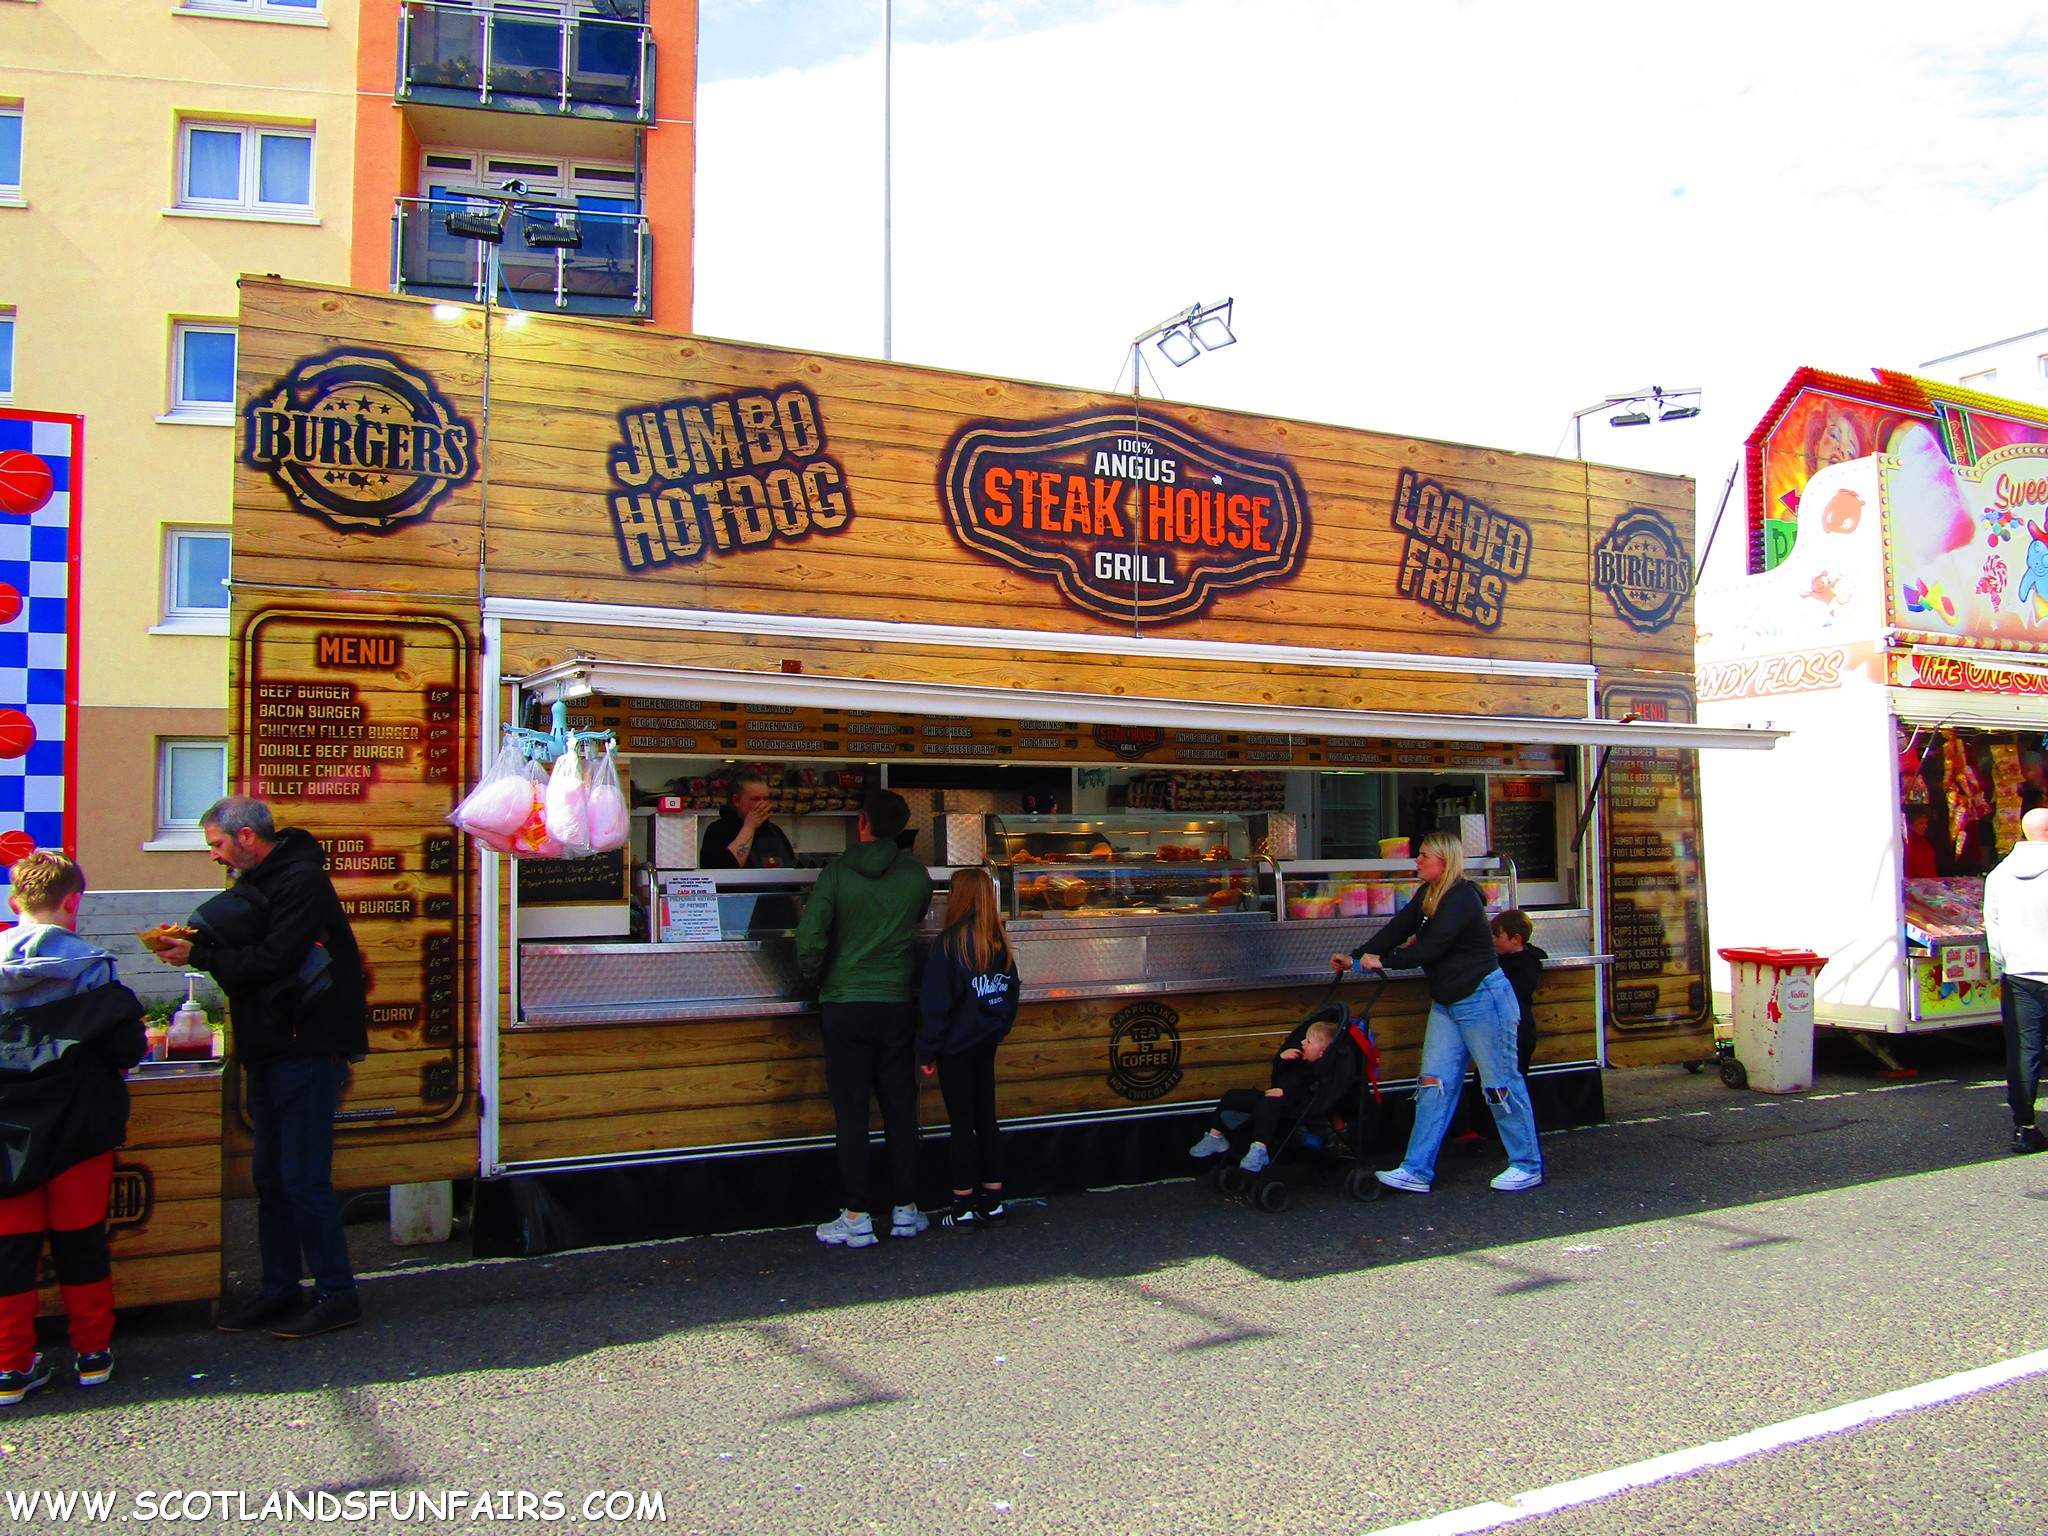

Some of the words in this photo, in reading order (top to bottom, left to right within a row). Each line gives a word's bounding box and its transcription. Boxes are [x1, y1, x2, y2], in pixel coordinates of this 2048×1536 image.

[258, 410, 470, 477] BURGERS
[616, 390, 818, 487] JUMBO
[1117, 438, 1153, 455] 100%
[1094, 452, 1176, 485] ANGUS
[614, 463, 848, 567] HOTDOG
[984, 467, 1125, 538] STEAK
[1149, 484, 1271, 551] HOUSE
[1396, 473, 1529, 578] LOADED
[1095, 552, 1174, 585] GRILL
[1601, 551, 1689, 592] BURGERS
[1401, 538, 1503, 626] FRIES
[320, 637, 395, 666] MENU
[1696, 661, 1758, 697] ANDY
[1755, 650, 1844, 692] FLOSS
[1920, 655, 1962, 686] THE
[260, 685, 293, 698] BEEF
[298, 686, 350, 700] BURGER
[259, 704, 304, 718] BACON
[308, 705, 360, 719] BURGER
[630, 699, 666, 710] CHICKEN
[668, 700, 701, 711] BURGER
[1634, 704, 1666, 720] MENU
[630, 717, 687, 729] VEGGIE/VEGAN
[688, 719, 718, 730] BURGER
[746, 720, 780, 731] CHICKEN
[780, 721, 804, 732] WRAP
[875, 724, 898, 735] CHIPS
[1035, 721, 1063, 731] DRINKS
[259, 724, 315, 738] CHICKEN
[320, 725, 364, 739] FILLET
[368, 726, 419, 740] BURGER
[922, 725, 944, 736] CHIPS
[944, 726, 973, 737] CHEESE
[1100, 728, 1128, 742] STEAK
[1130, 728, 1157, 743] HOUSE
[630, 737, 658, 747] JUMBO
[660, 738, 677, 747] HOT
[678, 738, 695, 748] DOG
[787, 740, 821, 751] SAUSAGE
[847, 742, 870, 752] CHIPS
[870, 742, 896, 753] CURRY
[1019, 738, 1034, 748] HOT
[1034, 739, 1059, 749] DRINKS
[1120, 743, 1137, 752] GRILL
[259, 744, 311, 758] DOUBLE
[315, 745, 349, 758] BEEF
[353, 745, 404, 759] BURGER
[922, 744, 944, 754] CHIPS
[944, 744, 971, 755] CHEESE
[971, 745, 996, 755] CURRY
[258, 764, 310, 777] DOUBLE
[315, 764, 370, 777] CHICKEN
[1611, 773, 1634, 782] DOUBLE
[1651, 774, 1672, 782] BURGER
[258, 782, 303, 795] FILLET
[308, 782, 360, 795] BURGER
[1636, 787, 1659, 795] CHICKEN
[1633, 798, 1656, 807] BURGER
[338, 840, 364, 853] DOG
[1613, 848, 1629, 857] FOOT
[1646, 847, 1672, 857] SAUSAGE
[335, 857, 396, 870] SAUSAGE
[1657, 875, 1680, 885] BURGER
[359, 900, 411, 914] BURGER
[1614, 926, 1631, 936] CHIPS
[1636, 949, 1659, 958] CHEESE
[1642, 960, 1660, 970] CHIPS
[373, 1007, 415, 1022] CURRY
[1112, 1004, 1176, 1027] CAPPUCCINO
[1132, 1027, 1157, 1040] TEA
[1122, 1053, 1168, 1067] COFFEE
[1110, 1076, 1127, 1091] HOT
[1128, 1071, 1180, 1099] CHOCOLATE
